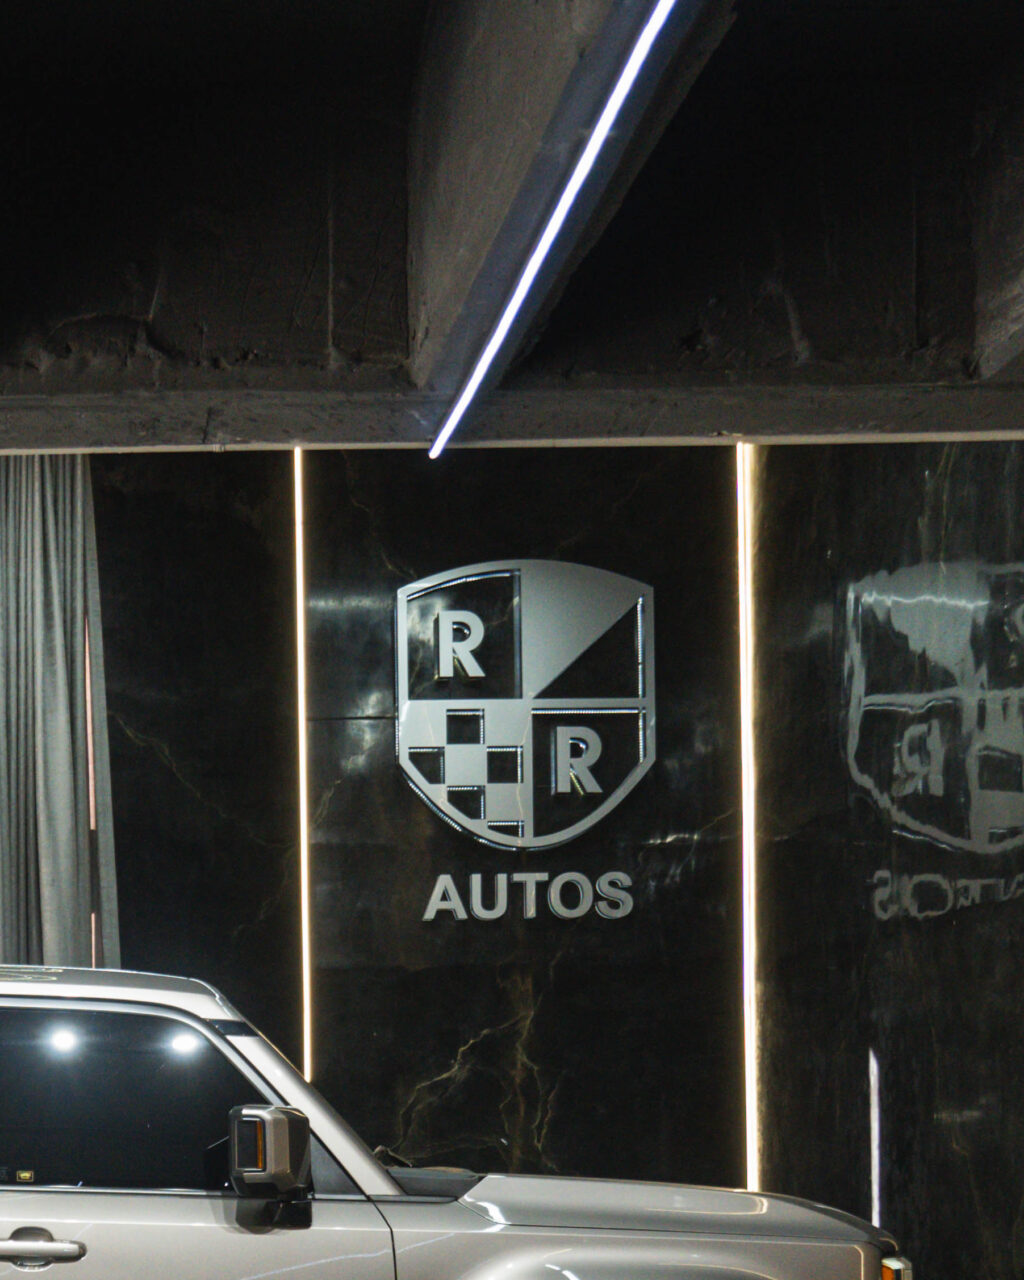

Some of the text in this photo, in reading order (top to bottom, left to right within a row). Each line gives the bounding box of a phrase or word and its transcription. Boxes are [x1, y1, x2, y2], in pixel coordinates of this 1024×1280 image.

[436, 609, 486, 679] R
[554, 725, 604, 794] R
[422, 870, 634, 921] AUTOS
